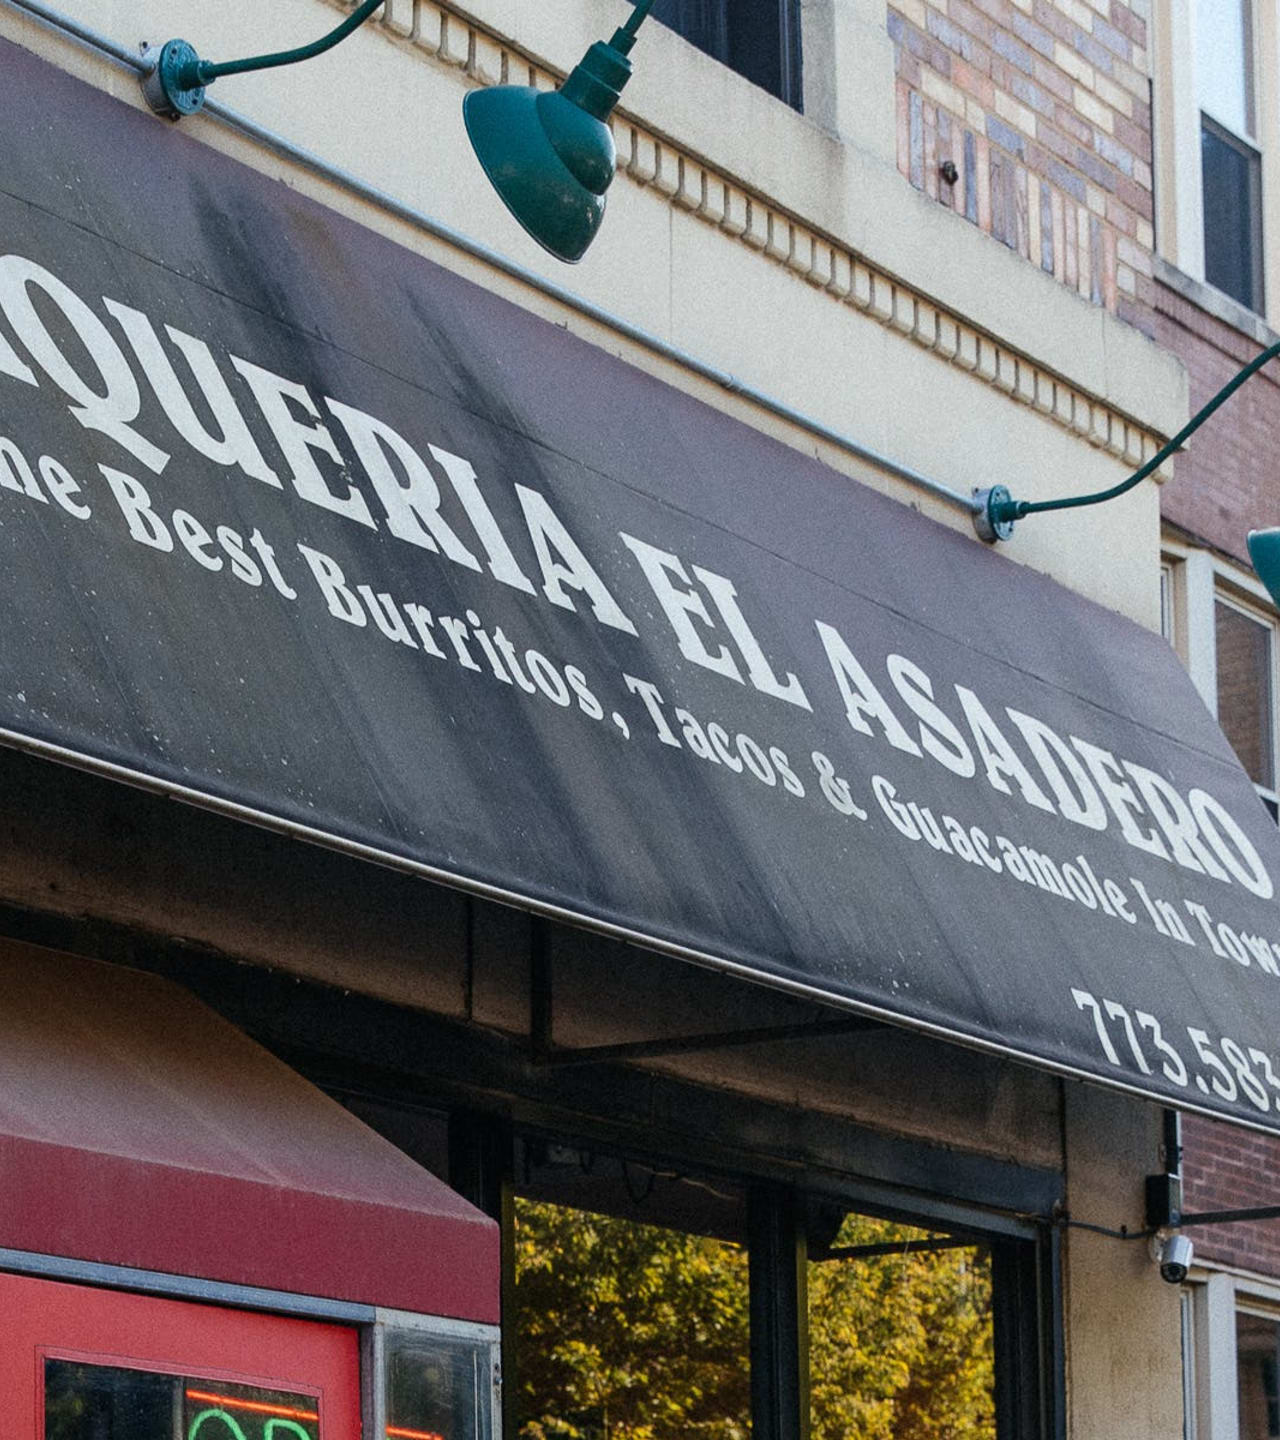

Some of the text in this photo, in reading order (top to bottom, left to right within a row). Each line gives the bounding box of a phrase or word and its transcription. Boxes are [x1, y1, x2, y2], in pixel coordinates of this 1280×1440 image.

[98, 463, 297, 600] Best
[297, 543, 630, 740] Burritos,
[623, 674, 806, 798] Tacos
[812, 751, 868, 820] &
[872, 775, 1137, 925] Guacamole
[1130, 878, 1197, 946] In
[619, 532, 813, 712] EL
[816, 619, 1274, 900] ASADERO
